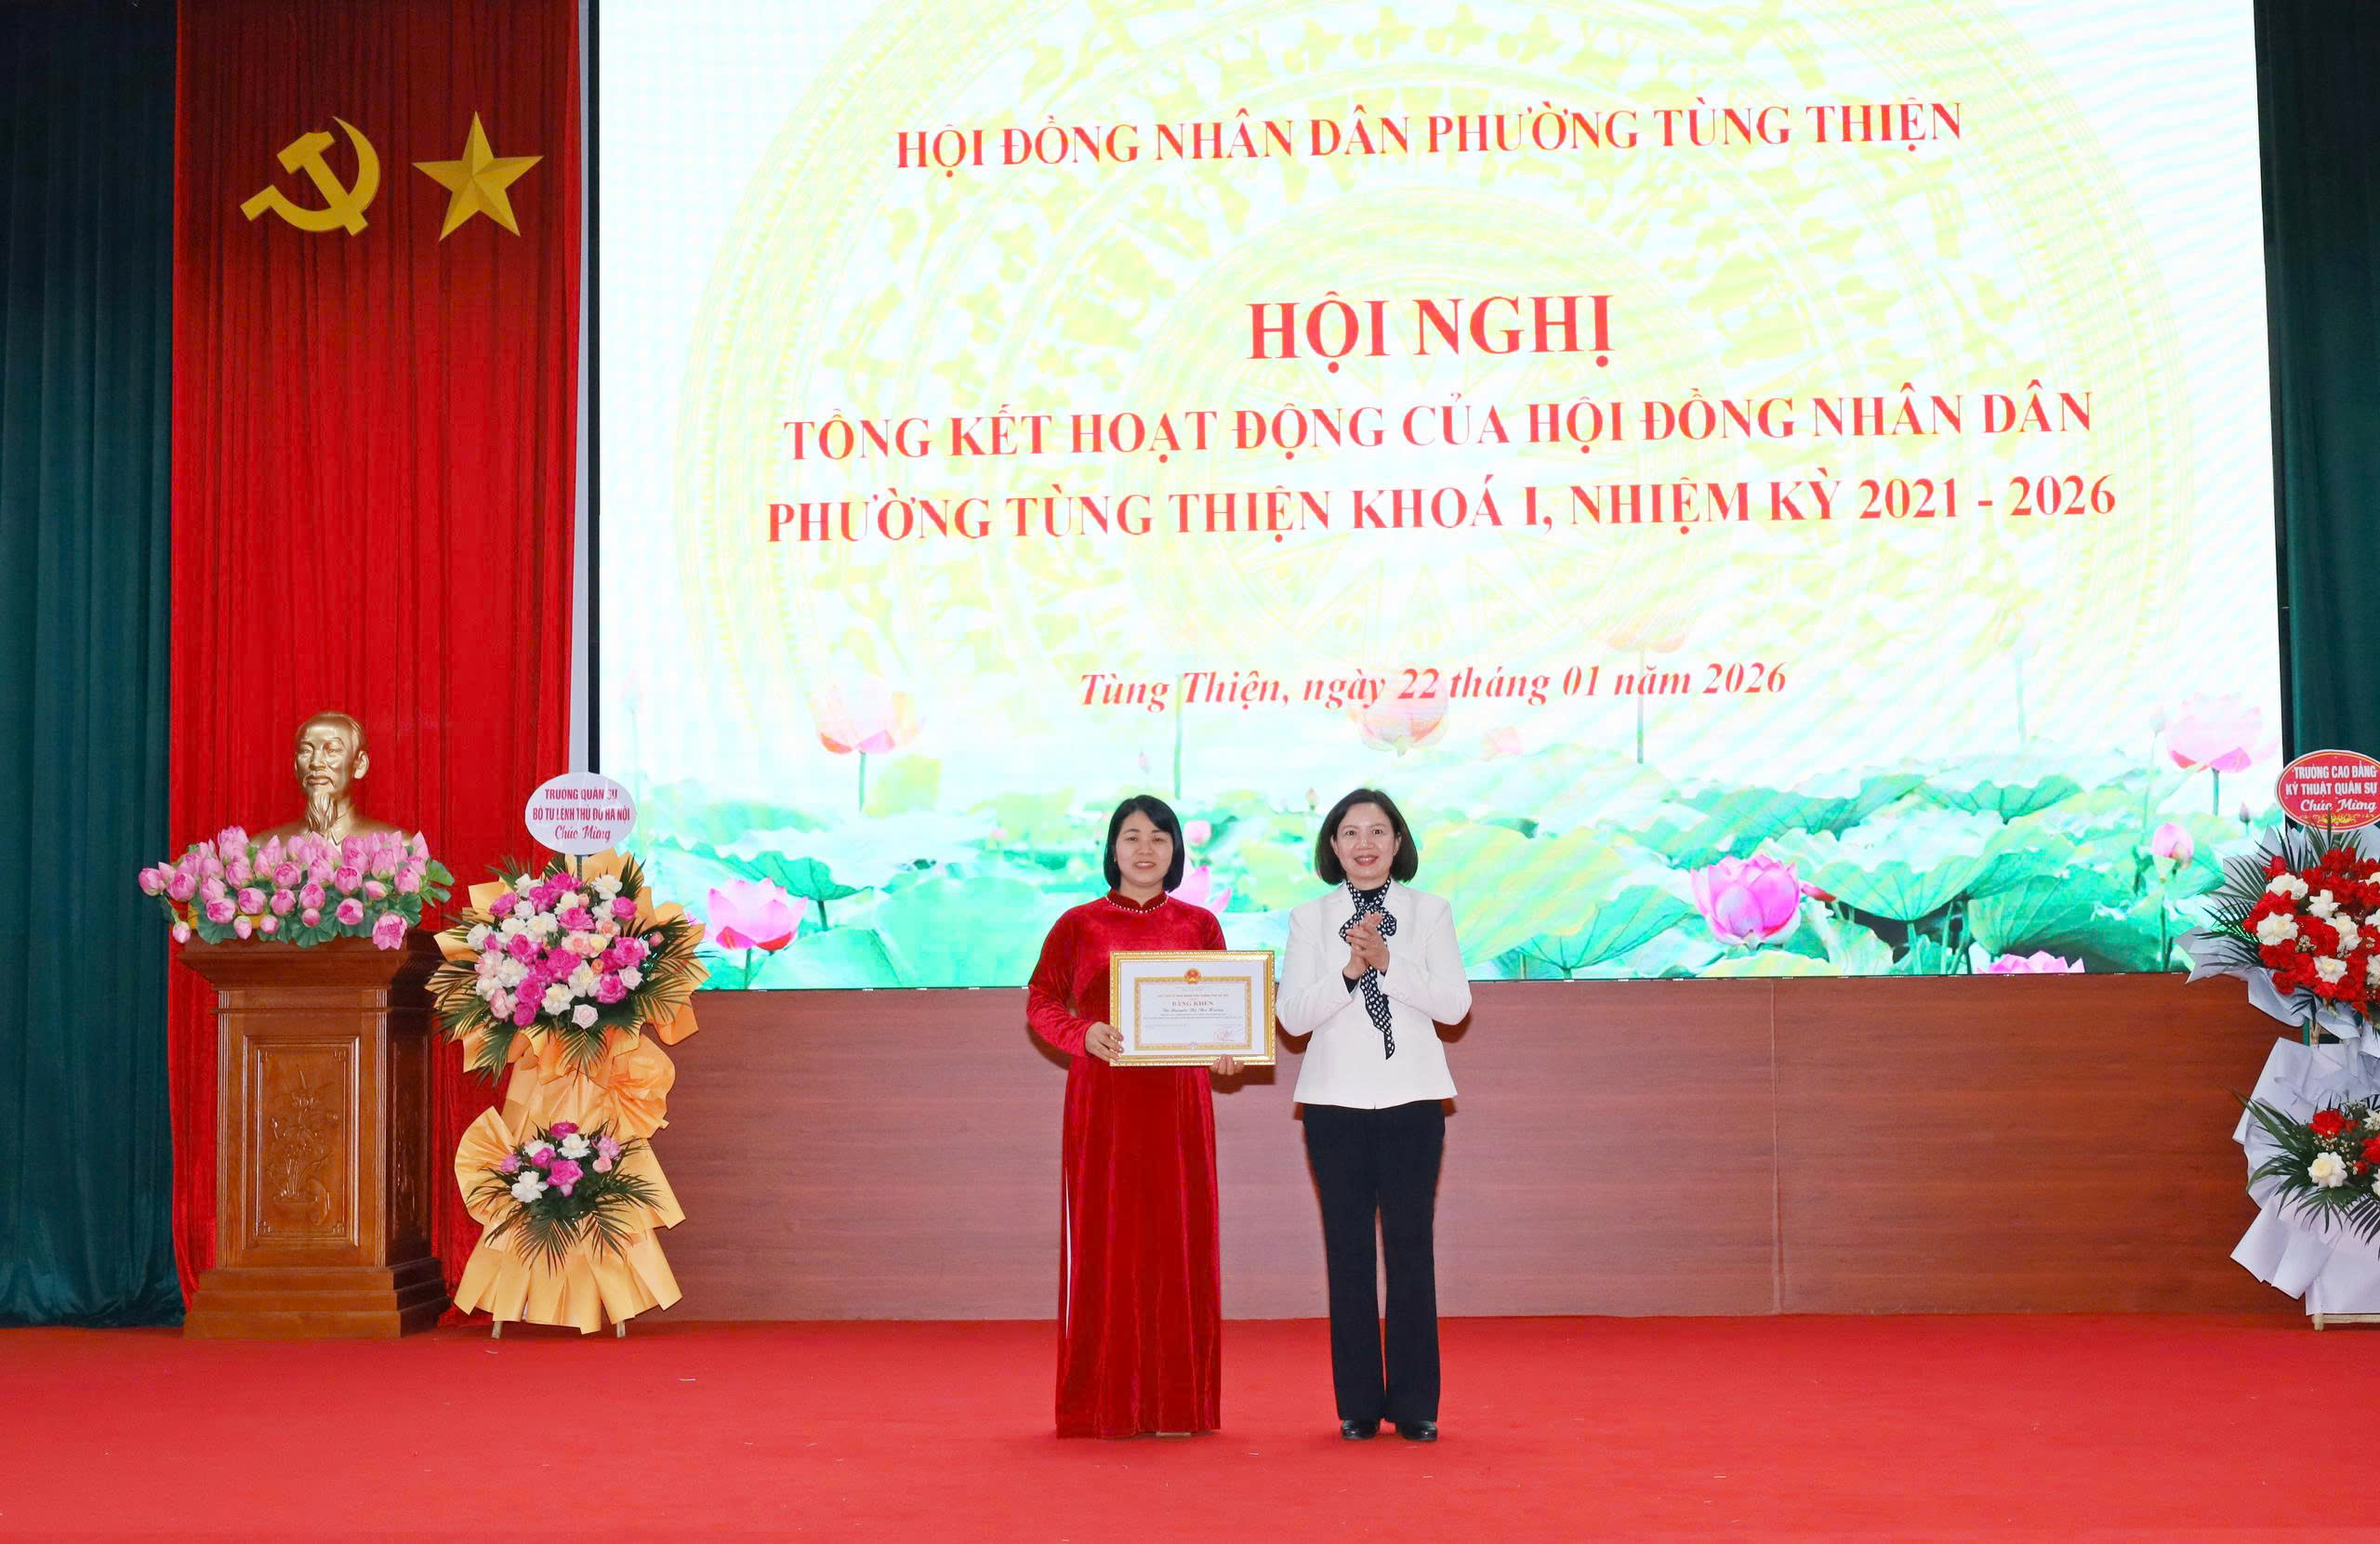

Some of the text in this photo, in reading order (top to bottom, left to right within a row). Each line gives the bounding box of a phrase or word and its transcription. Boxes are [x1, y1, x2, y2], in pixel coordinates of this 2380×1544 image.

[897, 97, 1964, 178] HỘI ĐỒNG NHÂN DÂN PHƯỜNG TÙNG THIỆN
[1246, 291, 1615, 374] HỘI NGHỊ
[950, 403, 1053, 456] KẾT
[1070, 411, 1218, 464] HOẠT
[1231, 402, 1385, 460] ĐỘNG
[1403, 392, 1510, 446] CỦA
[1526, 396, 1624, 455] HỘI
[1639, 388, 1795, 441] ĐỒNG
[1813, 382, 1964, 438] NHÂN
[1983, 379, 2093, 434] DÂN
[768, 468, 2117, 544] PHƯỜNG TÙNG THIỆN KHOÁ I, NHIỆM KỲ 2021 - 2026
[1080, 661, 1788, 713] Tùng Thiện, ngày 22 tháng 01 năm 2026
[2331, 765, 2350, 779] CAO
[2334, 781, 2362, 797] QUÂN
[2300, 799, 2333, 812] Chúc
